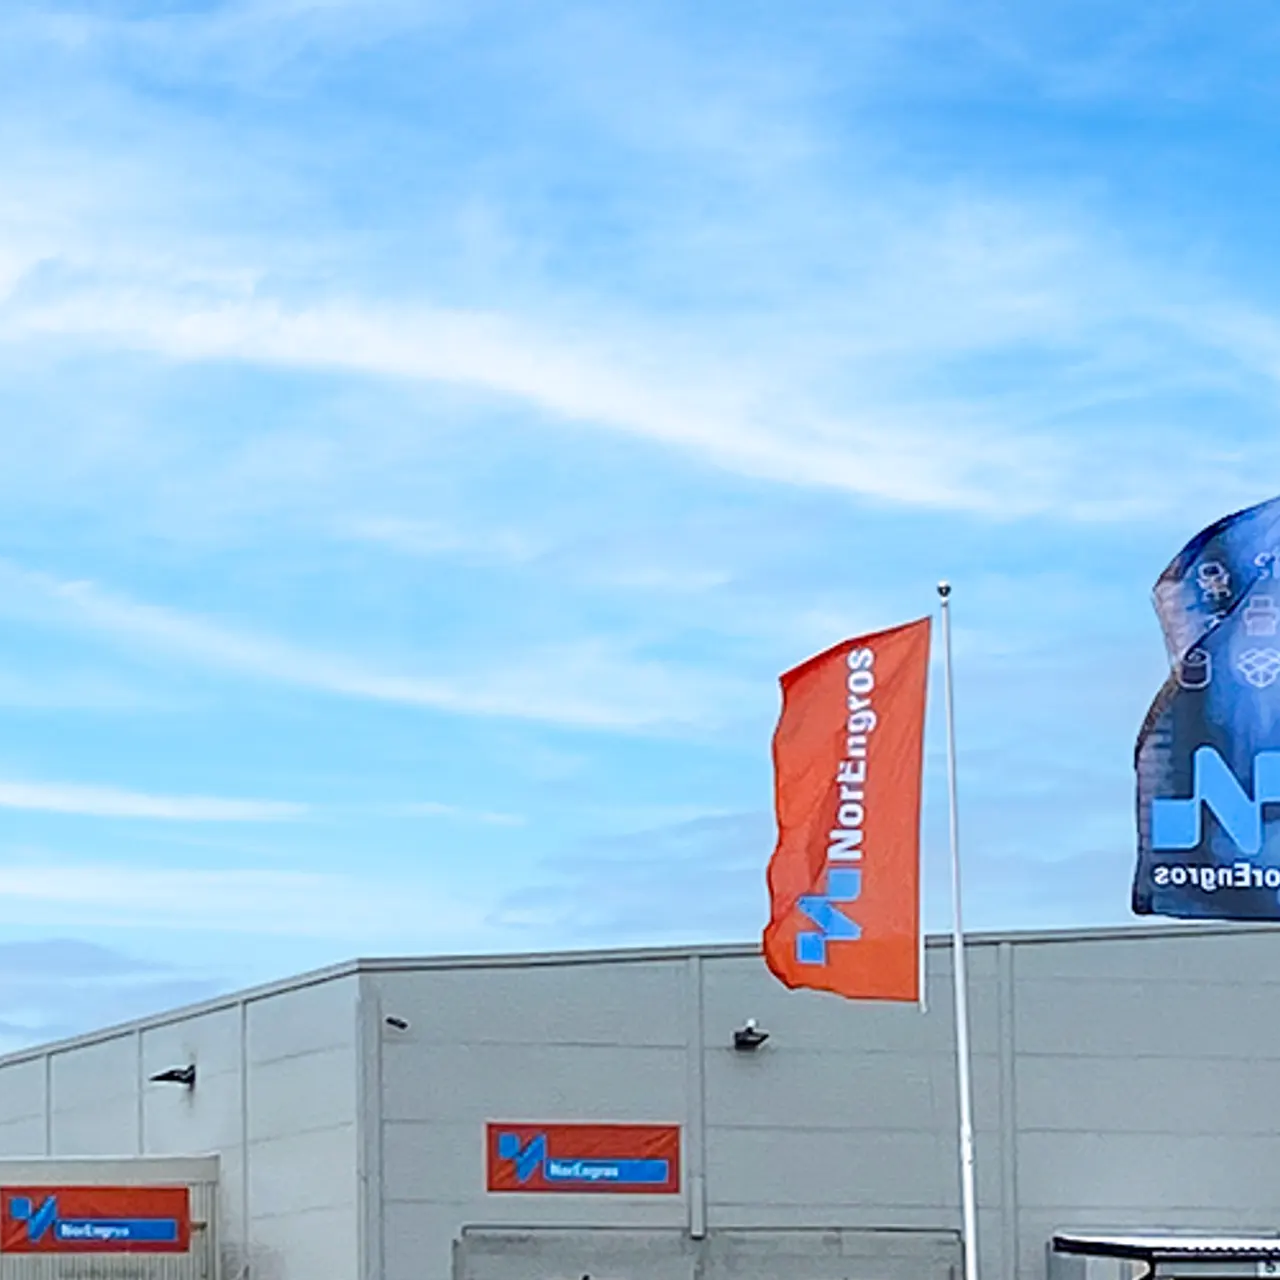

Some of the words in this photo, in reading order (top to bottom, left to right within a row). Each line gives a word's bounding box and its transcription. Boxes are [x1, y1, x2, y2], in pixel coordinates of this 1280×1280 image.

[827, 645, 878, 862] NorEngros
[549, 1161, 619, 1180] NorEngros
[60, 1223, 130, 1240] NorEngros
